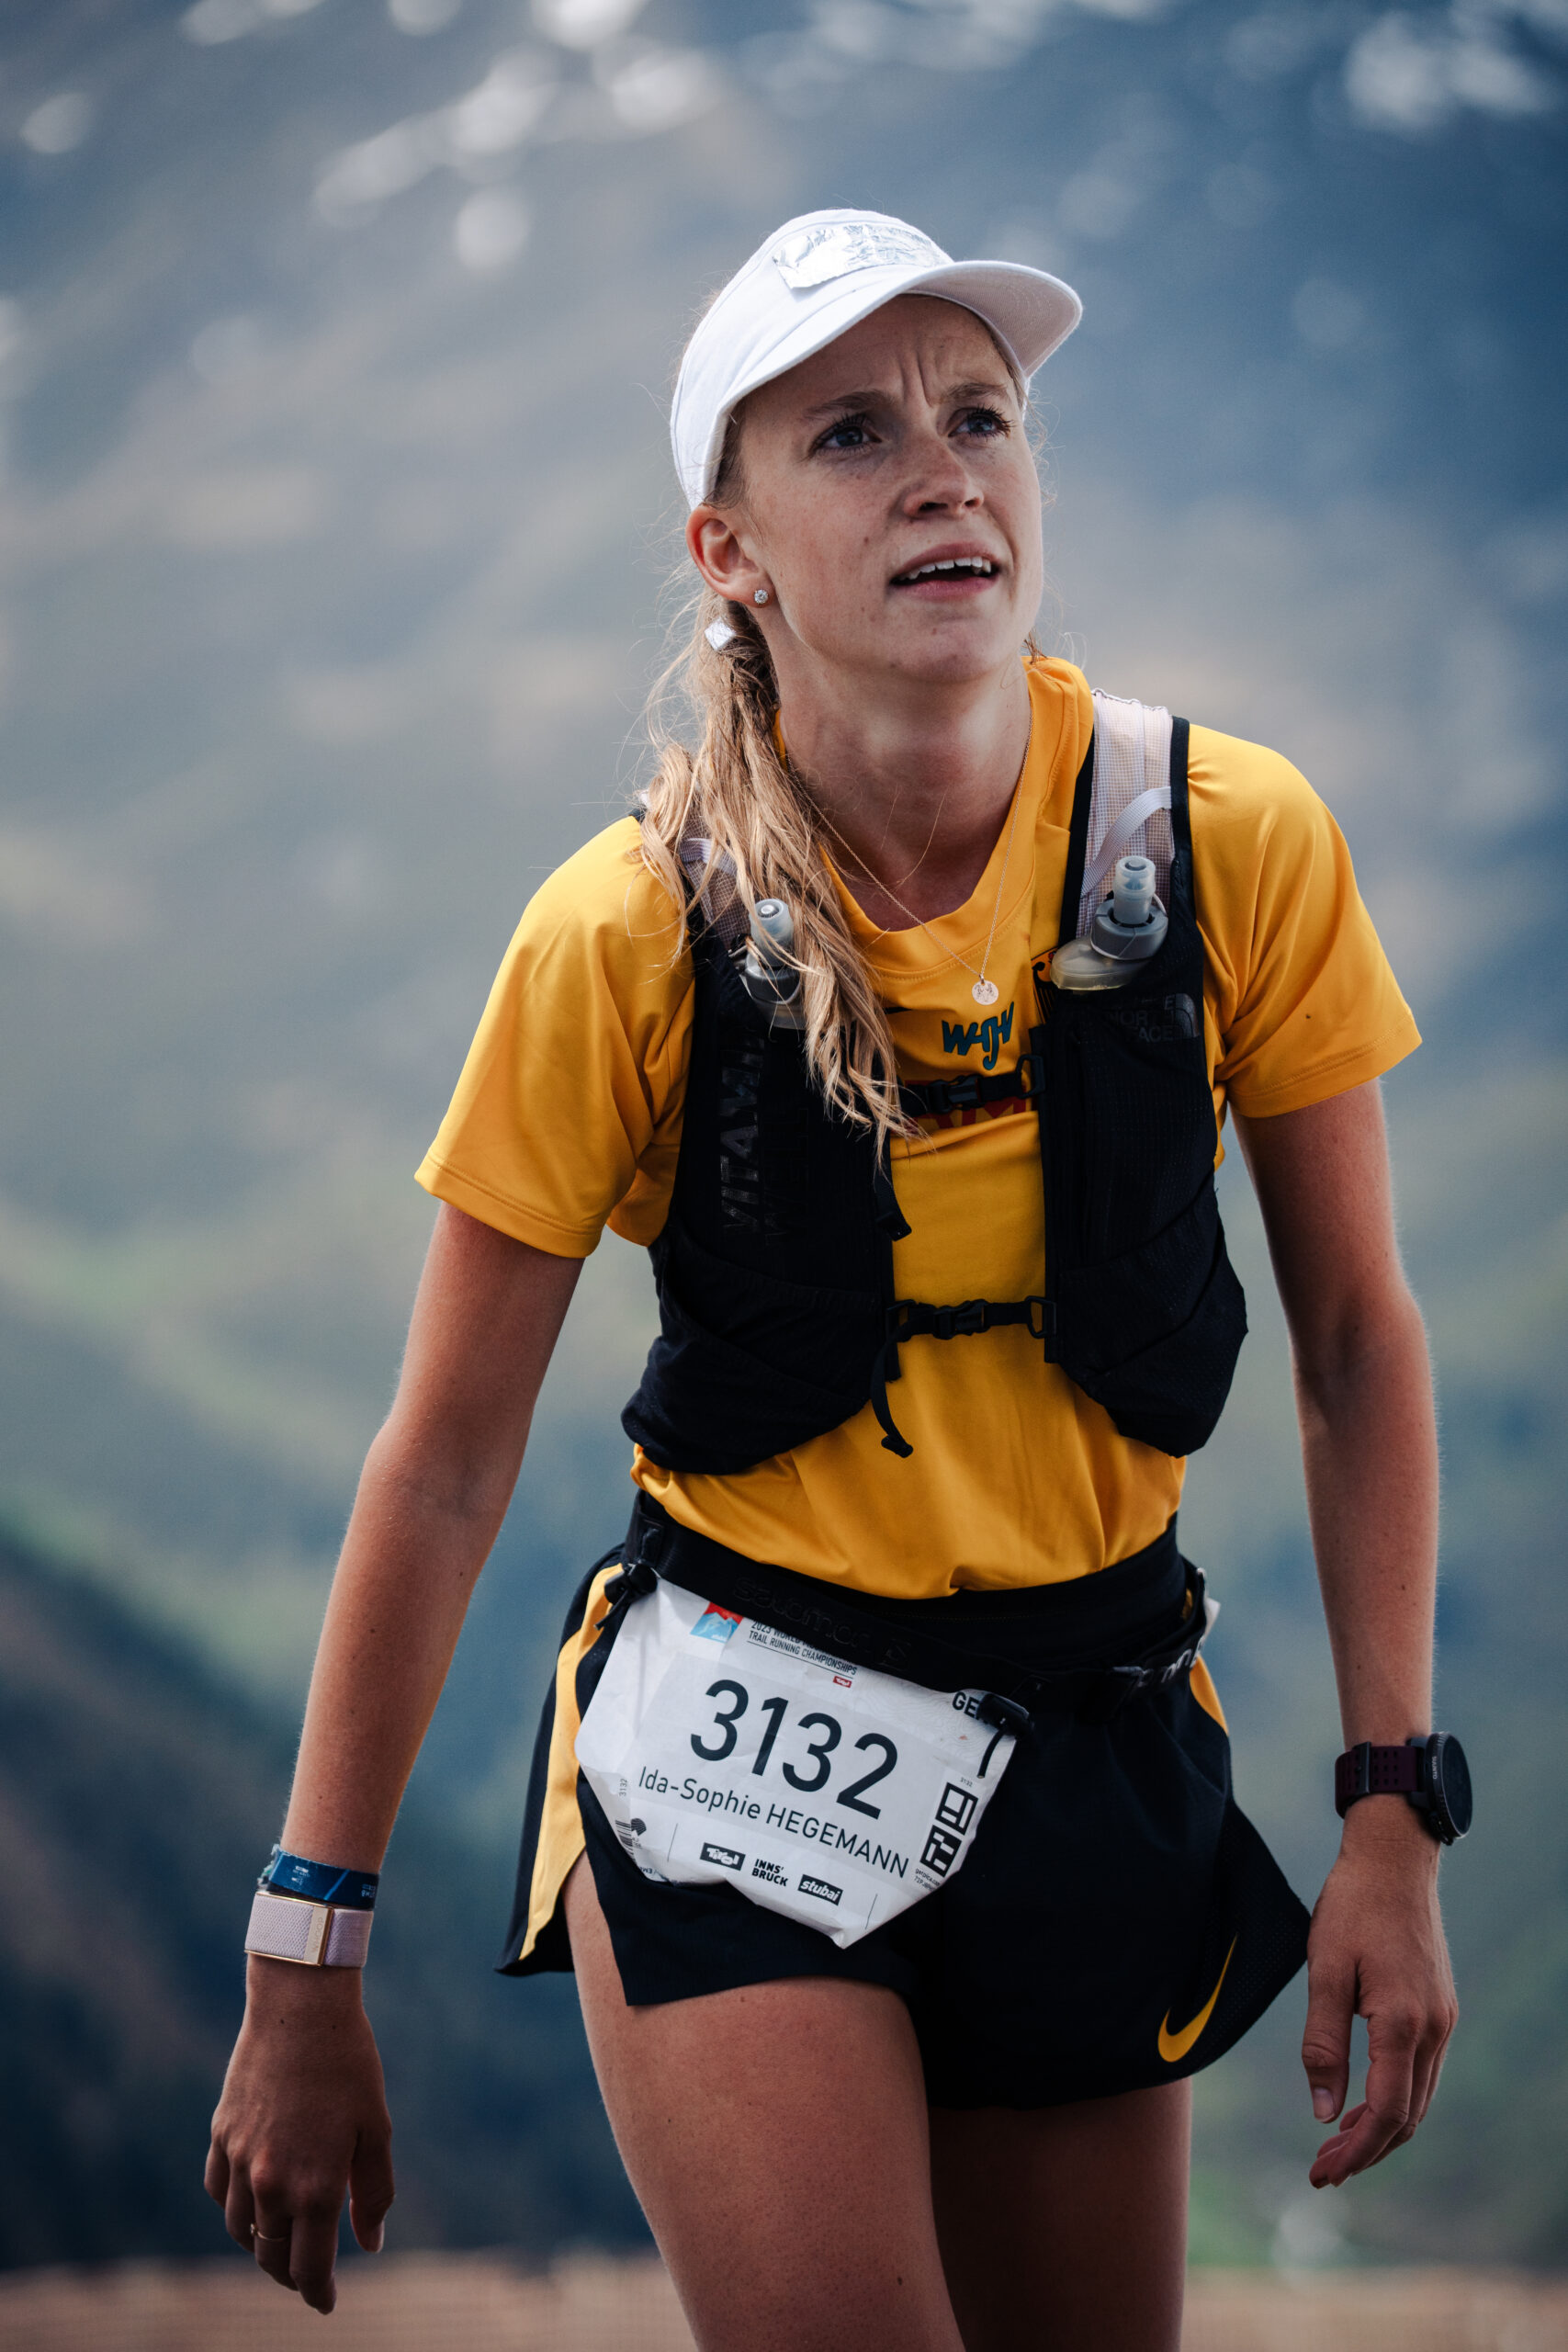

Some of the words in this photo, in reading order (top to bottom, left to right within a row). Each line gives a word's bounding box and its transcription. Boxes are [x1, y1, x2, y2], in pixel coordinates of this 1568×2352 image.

[749, 1630, 767, 1645] TRAIL
[770, 1637, 800, 1655] RUNNING
[802, 1648, 857, 1675] CHAMPIONSHIPS
[690, 1679, 898, 1820] 3132
[619, 1778, 628, 1797] 3132
[638, 1766, 761, 1819] Ida-Sophie
[765, 1804, 909, 1879] HEGEMANN
[706, 1847, 739, 1867] Tirol
[751, 1868, 789, 1886] BRUCK
[800, 1880, 840, 1902] stubai
